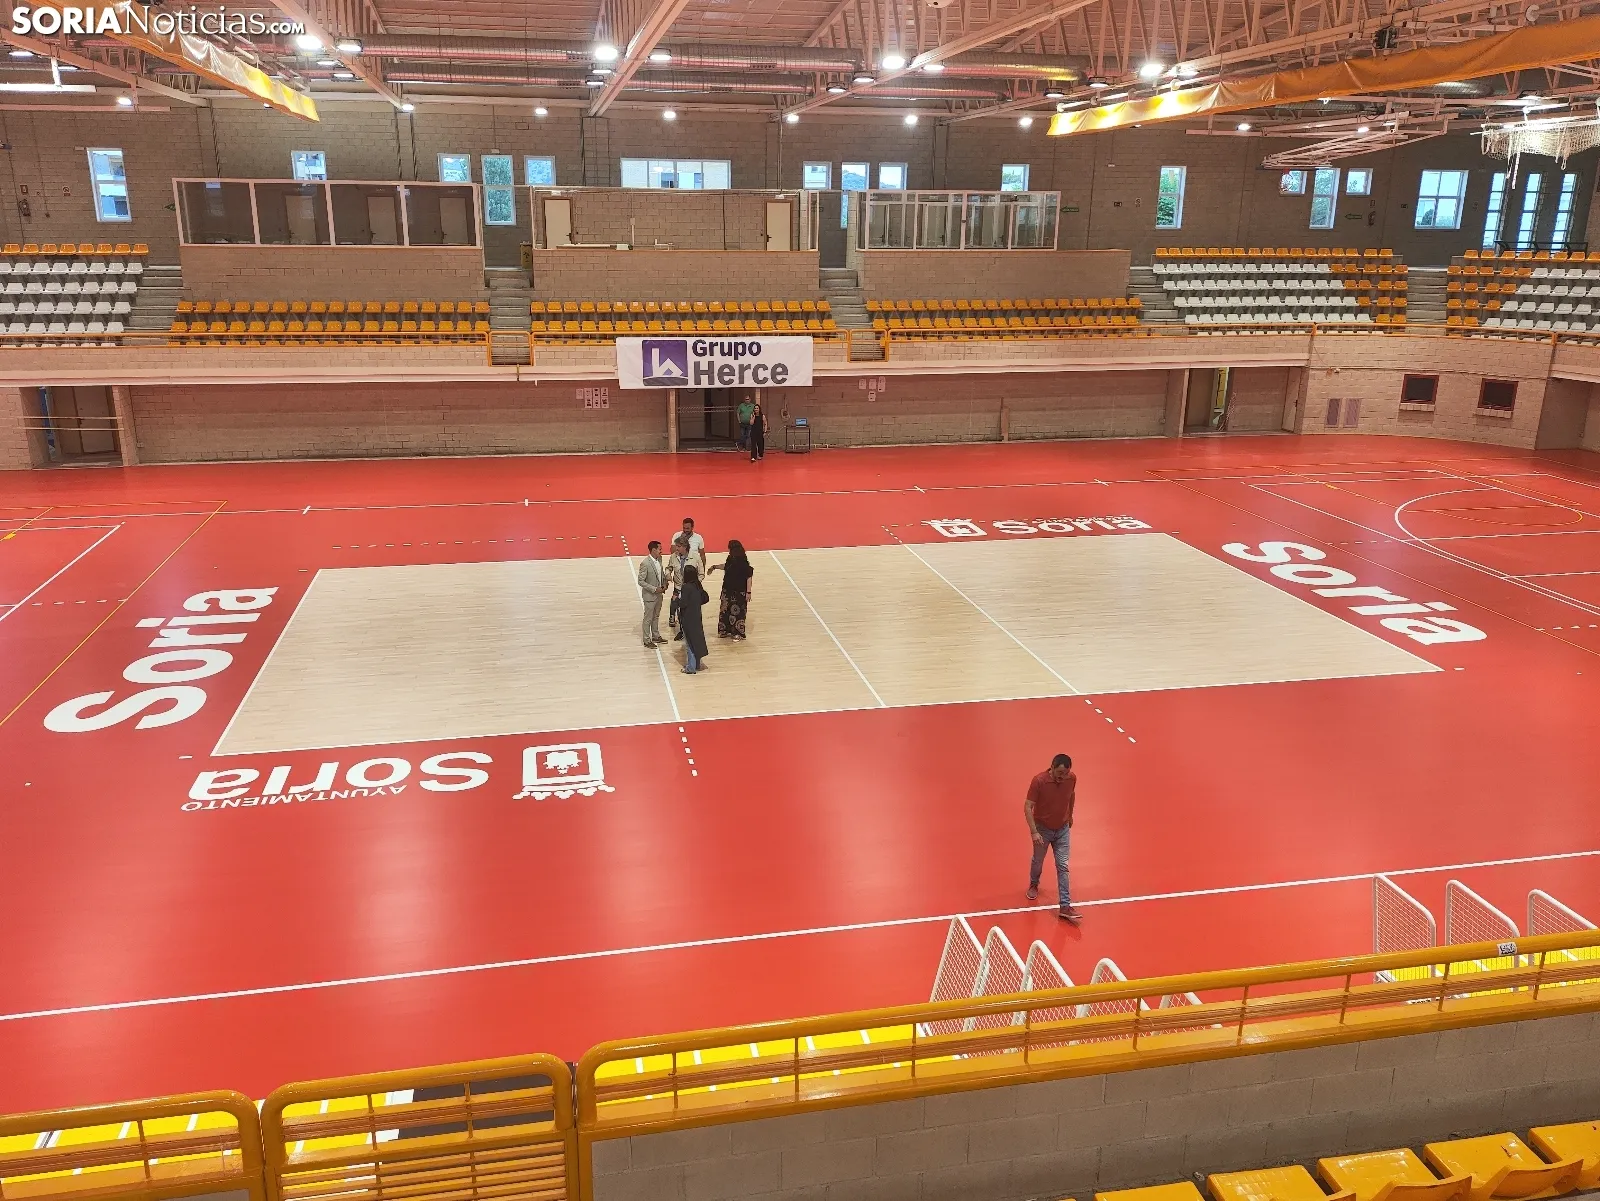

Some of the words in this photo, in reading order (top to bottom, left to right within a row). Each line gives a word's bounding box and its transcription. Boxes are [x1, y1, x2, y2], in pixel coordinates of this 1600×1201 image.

[691, 339, 762, 361] Grupo
[693, 361, 789, 386] Herce
[992, 516, 1152, 535] Soria
[1221, 541, 1487, 646] Soria
[43, 586, 280, 733] Soria
[188, 751, 493, 801] Soria
[180, 784, 407, 812] AYUNTAMIENTO
